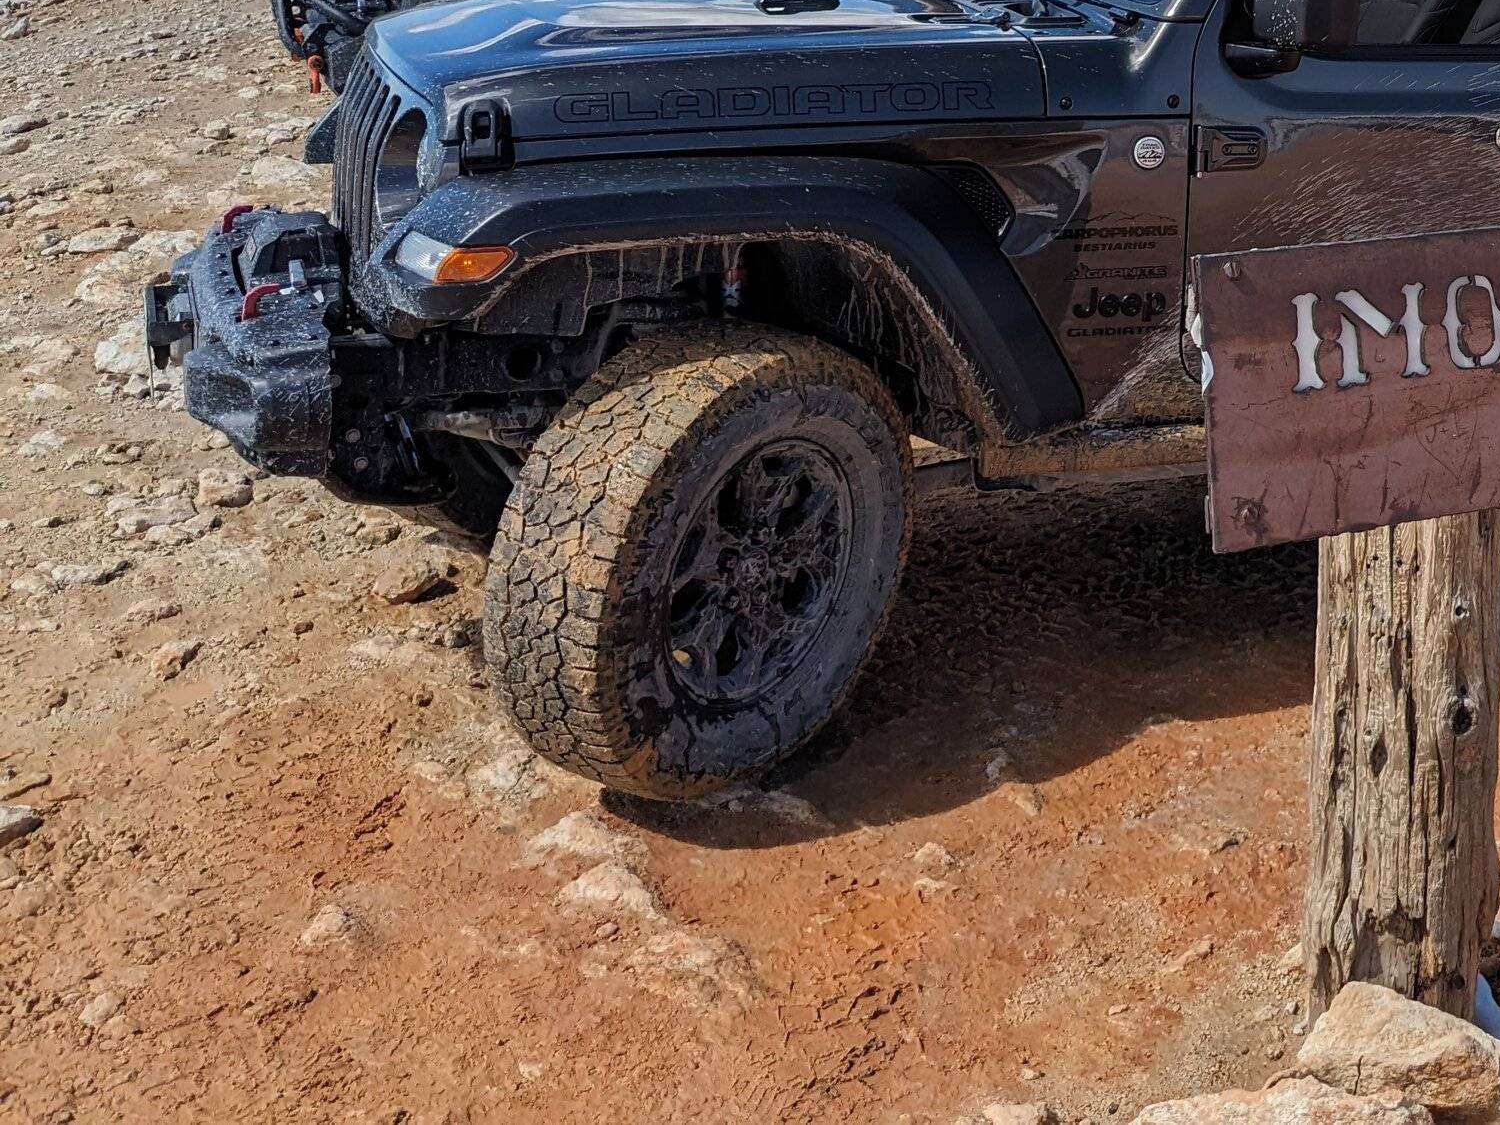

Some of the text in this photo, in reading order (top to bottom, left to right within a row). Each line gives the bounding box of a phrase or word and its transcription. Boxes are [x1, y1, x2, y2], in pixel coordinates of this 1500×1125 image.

[554, 80, 995, 124] GLADIATOR
[1073, 241, 1157, 253] BESTIARIUS
[1072, 286, 1167, 322] Jeep
